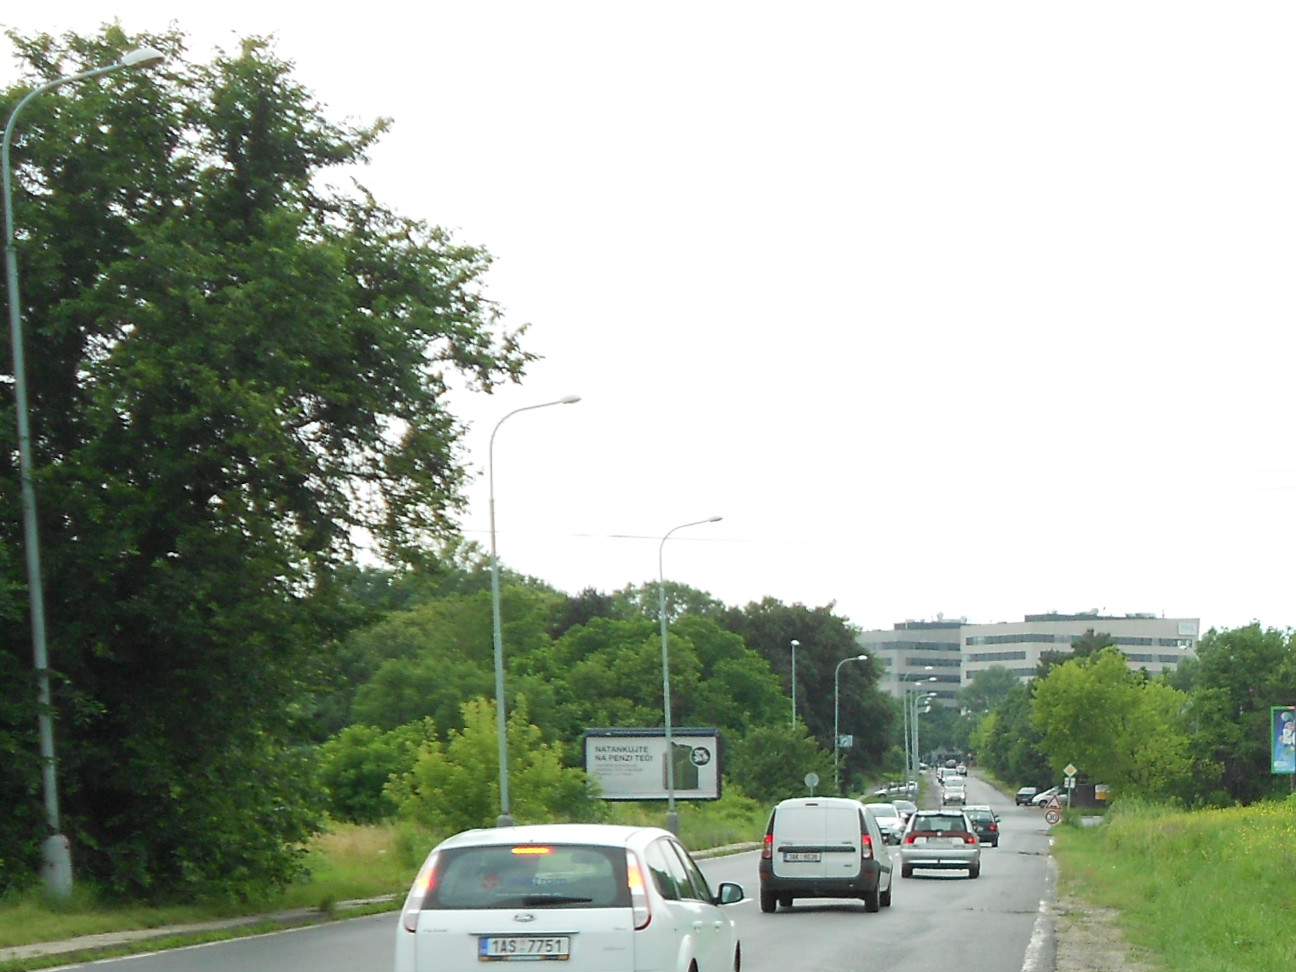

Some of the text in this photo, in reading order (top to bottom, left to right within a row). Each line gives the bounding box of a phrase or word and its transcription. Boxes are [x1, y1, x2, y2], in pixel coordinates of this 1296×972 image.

[595, 745, 648, 753] NATANKUJTE
[492, 939, 561, 953] 1AS 7751
